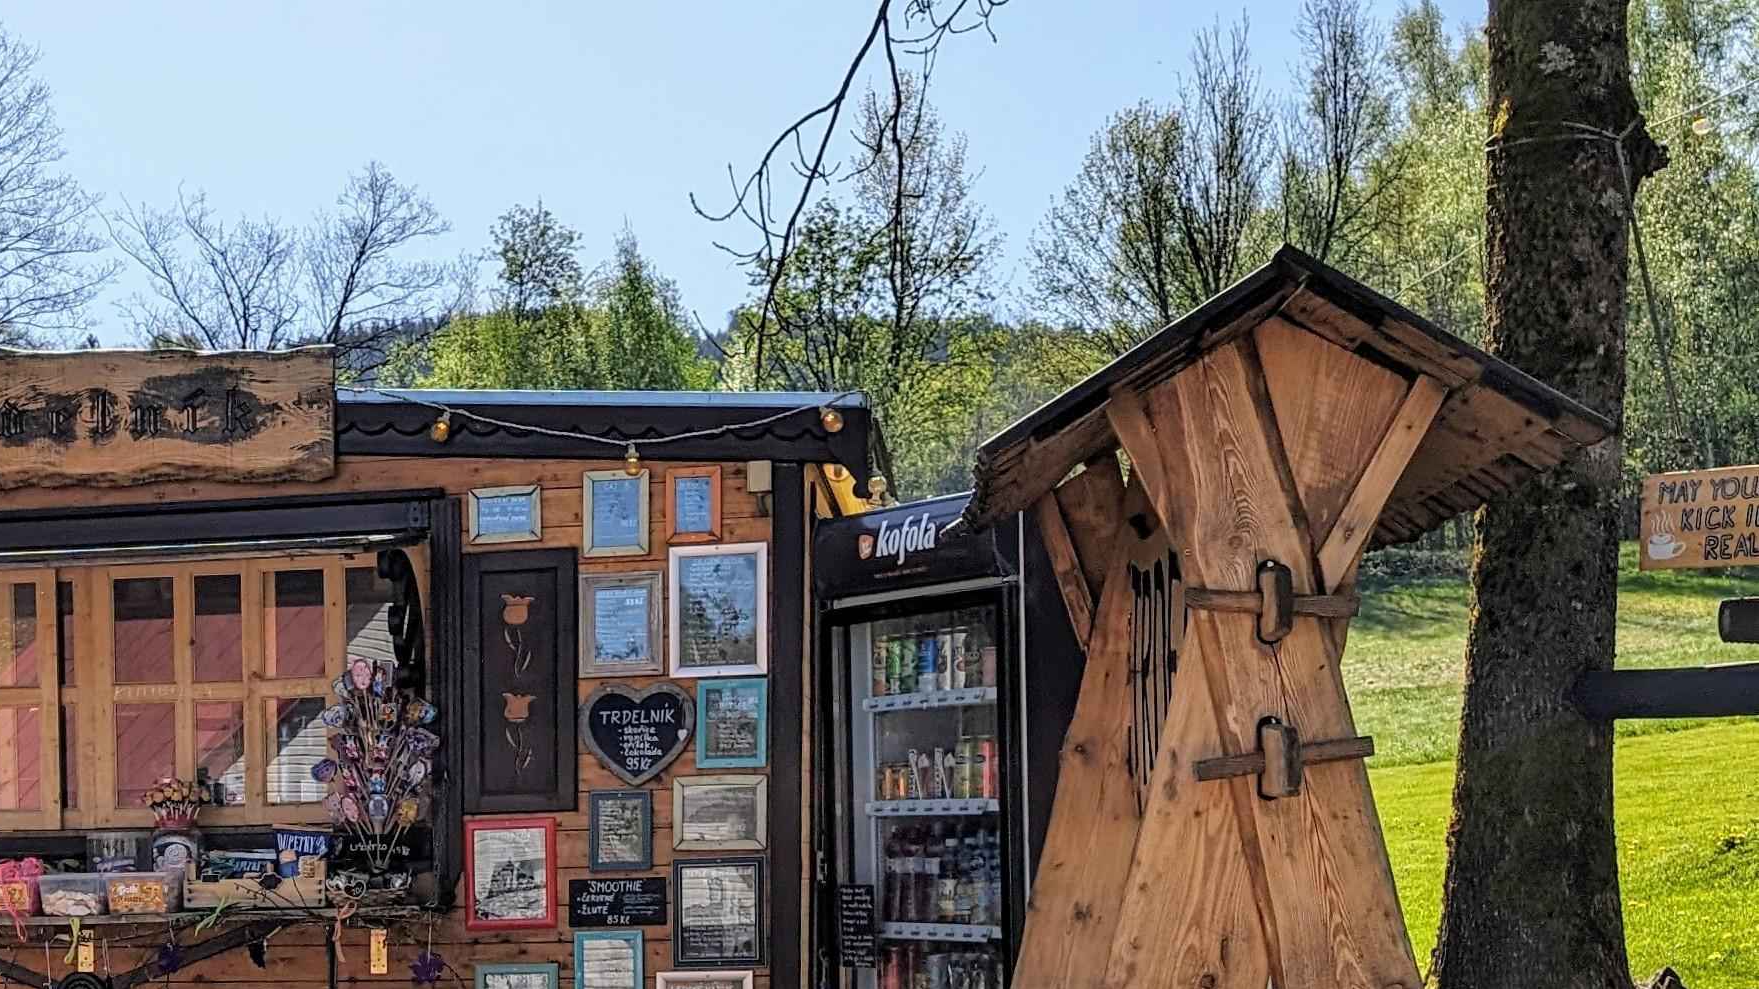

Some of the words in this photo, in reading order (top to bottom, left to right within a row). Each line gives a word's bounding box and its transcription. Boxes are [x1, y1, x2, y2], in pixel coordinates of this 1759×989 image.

[1658, 480, 1702, 504] MAY
[1681, 505, 1736, 532] KICK
[875, 513, 936, 565] kofola
[589, 880, 642, 893] SMOOTHIE
